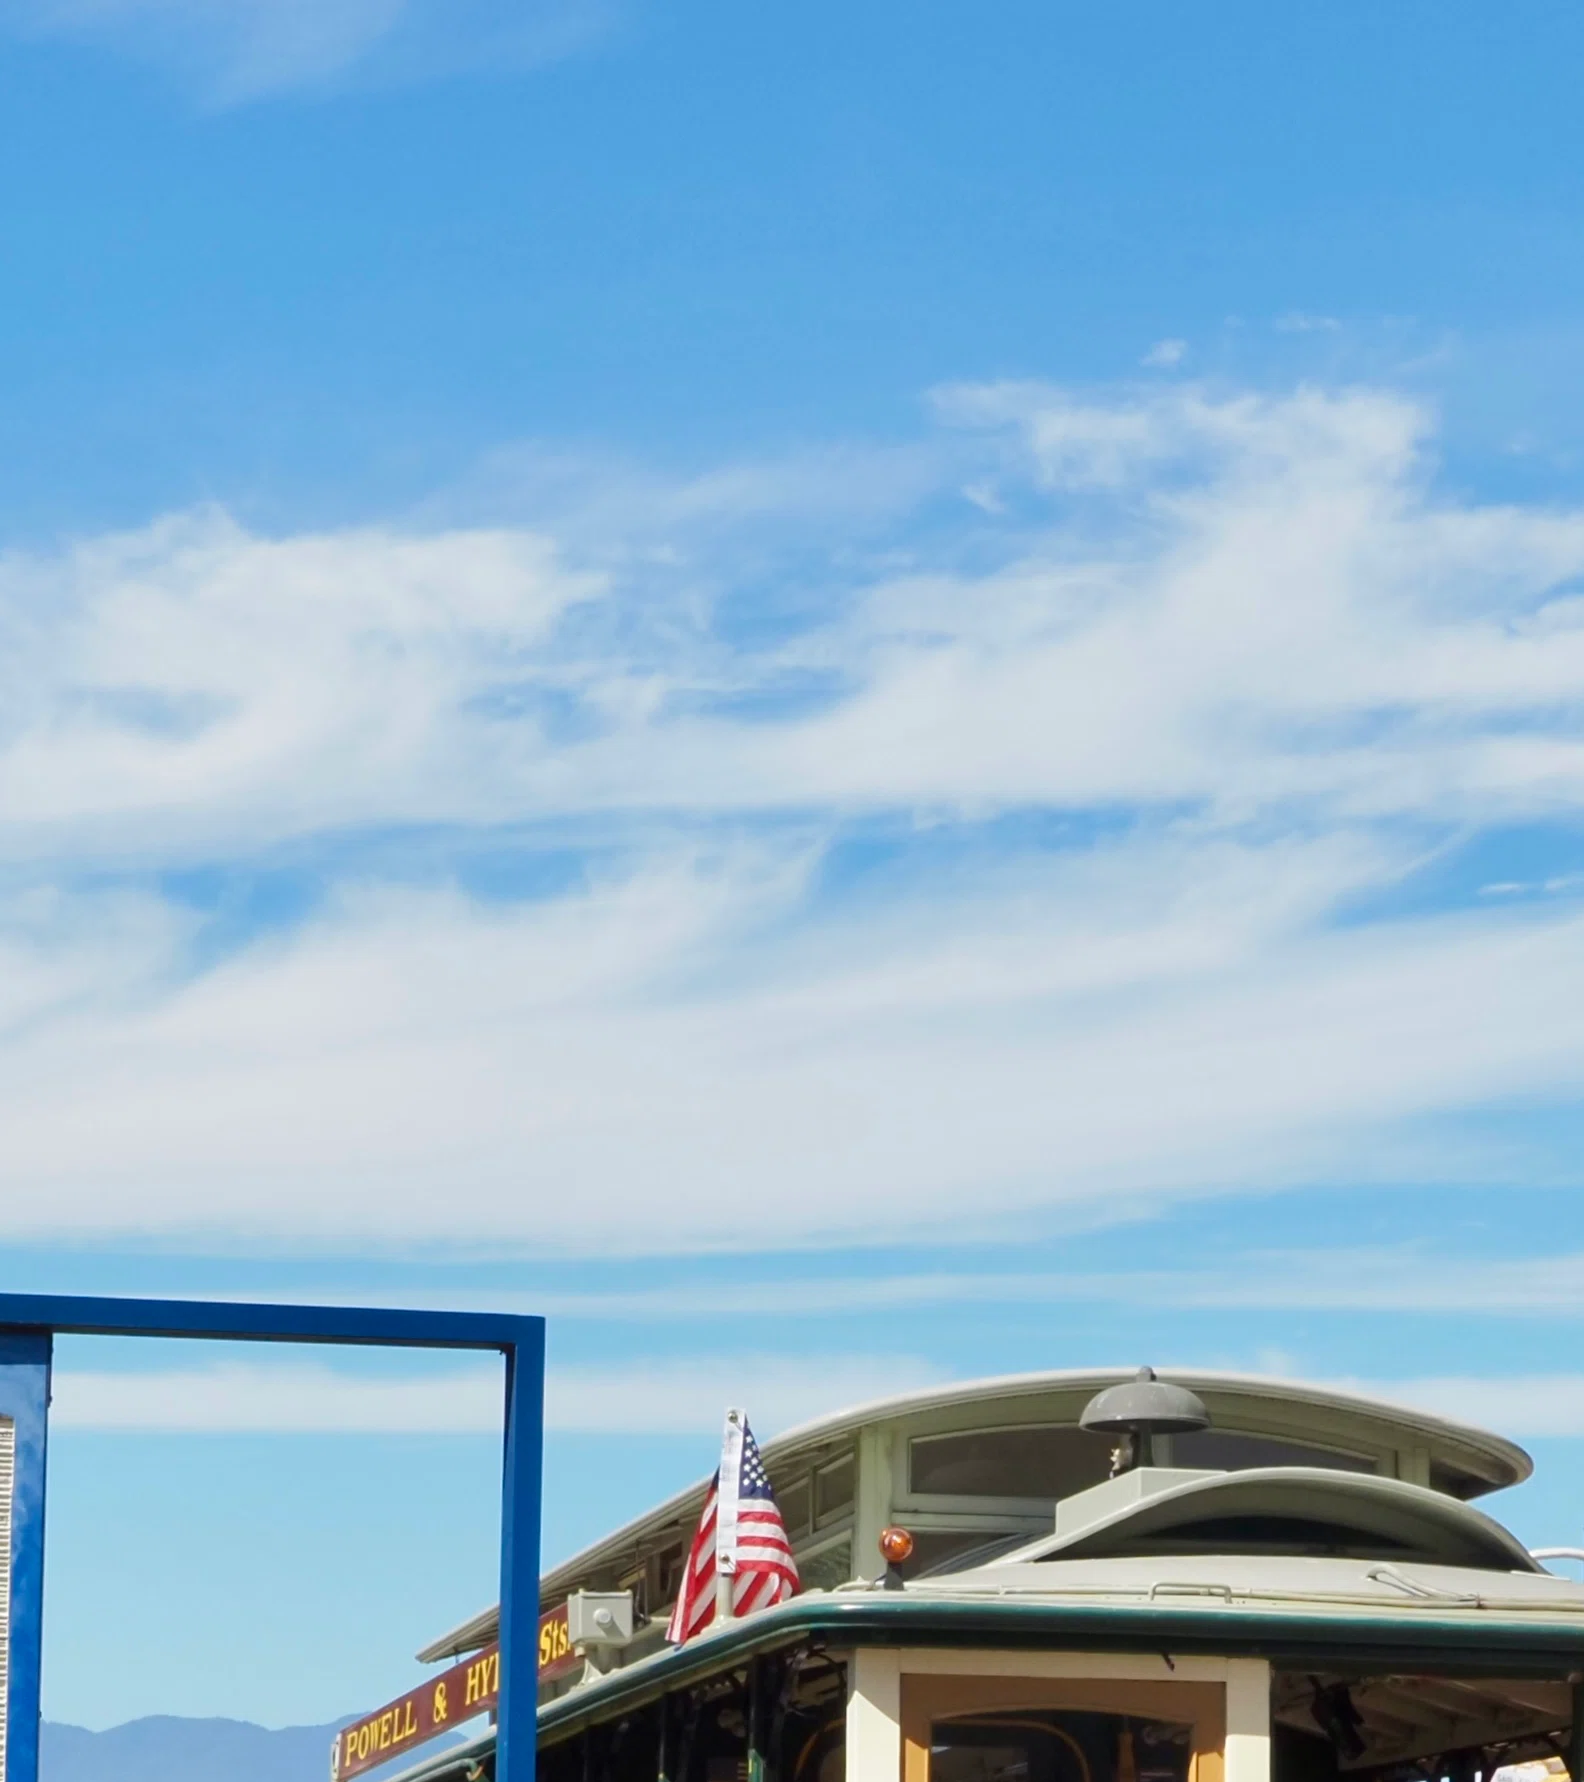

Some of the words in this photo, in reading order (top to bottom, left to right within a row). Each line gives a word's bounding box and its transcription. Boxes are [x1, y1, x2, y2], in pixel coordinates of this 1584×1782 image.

[343, 1700, 417, 1768] POWELL
[433, 1681, 447, 1724] &
[465, 1651, 500, 1706] HY
